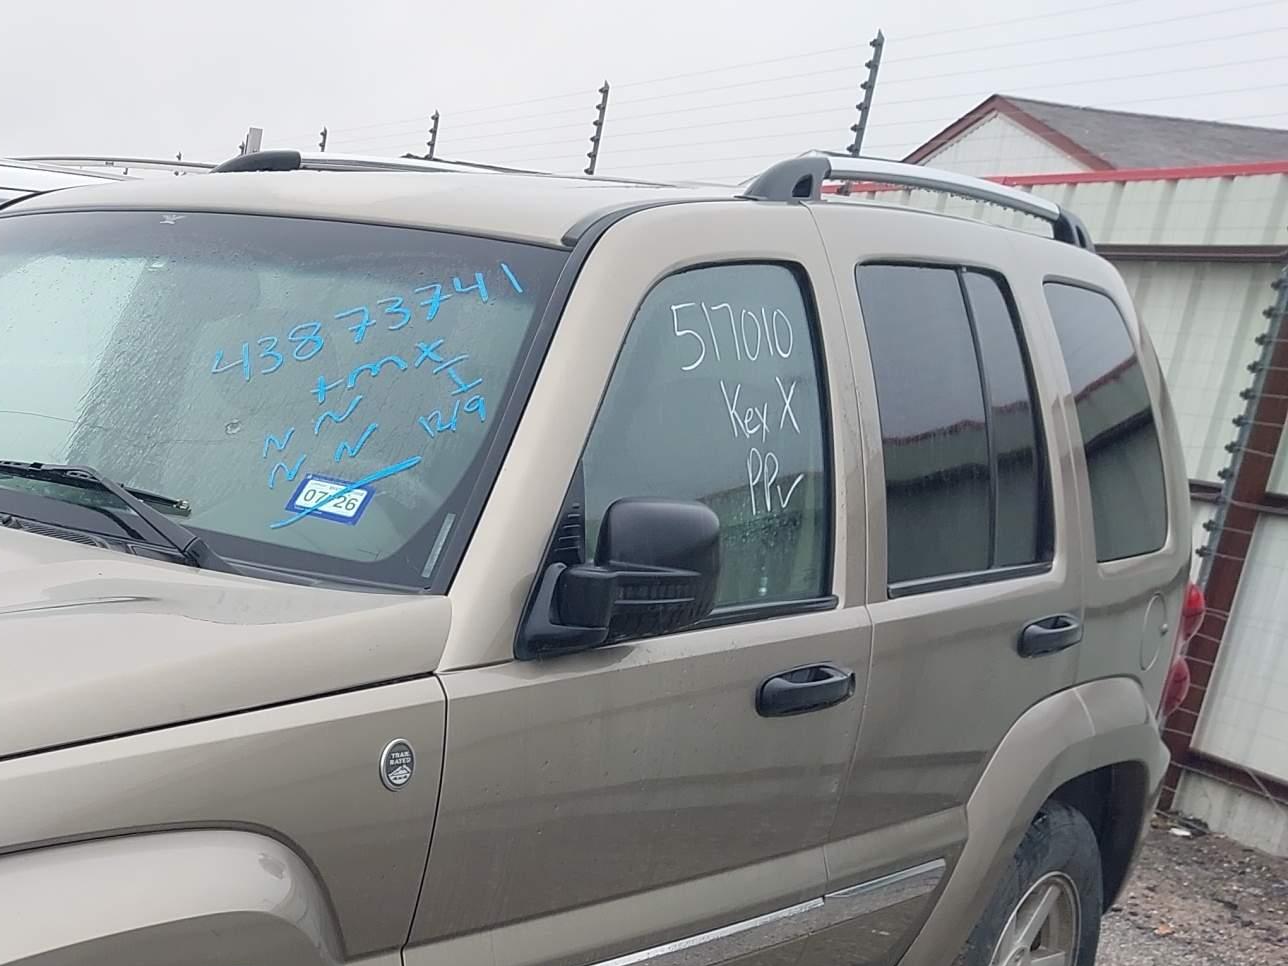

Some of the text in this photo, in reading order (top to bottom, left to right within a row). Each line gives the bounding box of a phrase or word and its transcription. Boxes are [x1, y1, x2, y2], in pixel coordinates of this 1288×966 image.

[211, 262, 524, 383] 43873741
[670, 301, 793, 371] 517010
[775, 376, 801, 434] X
